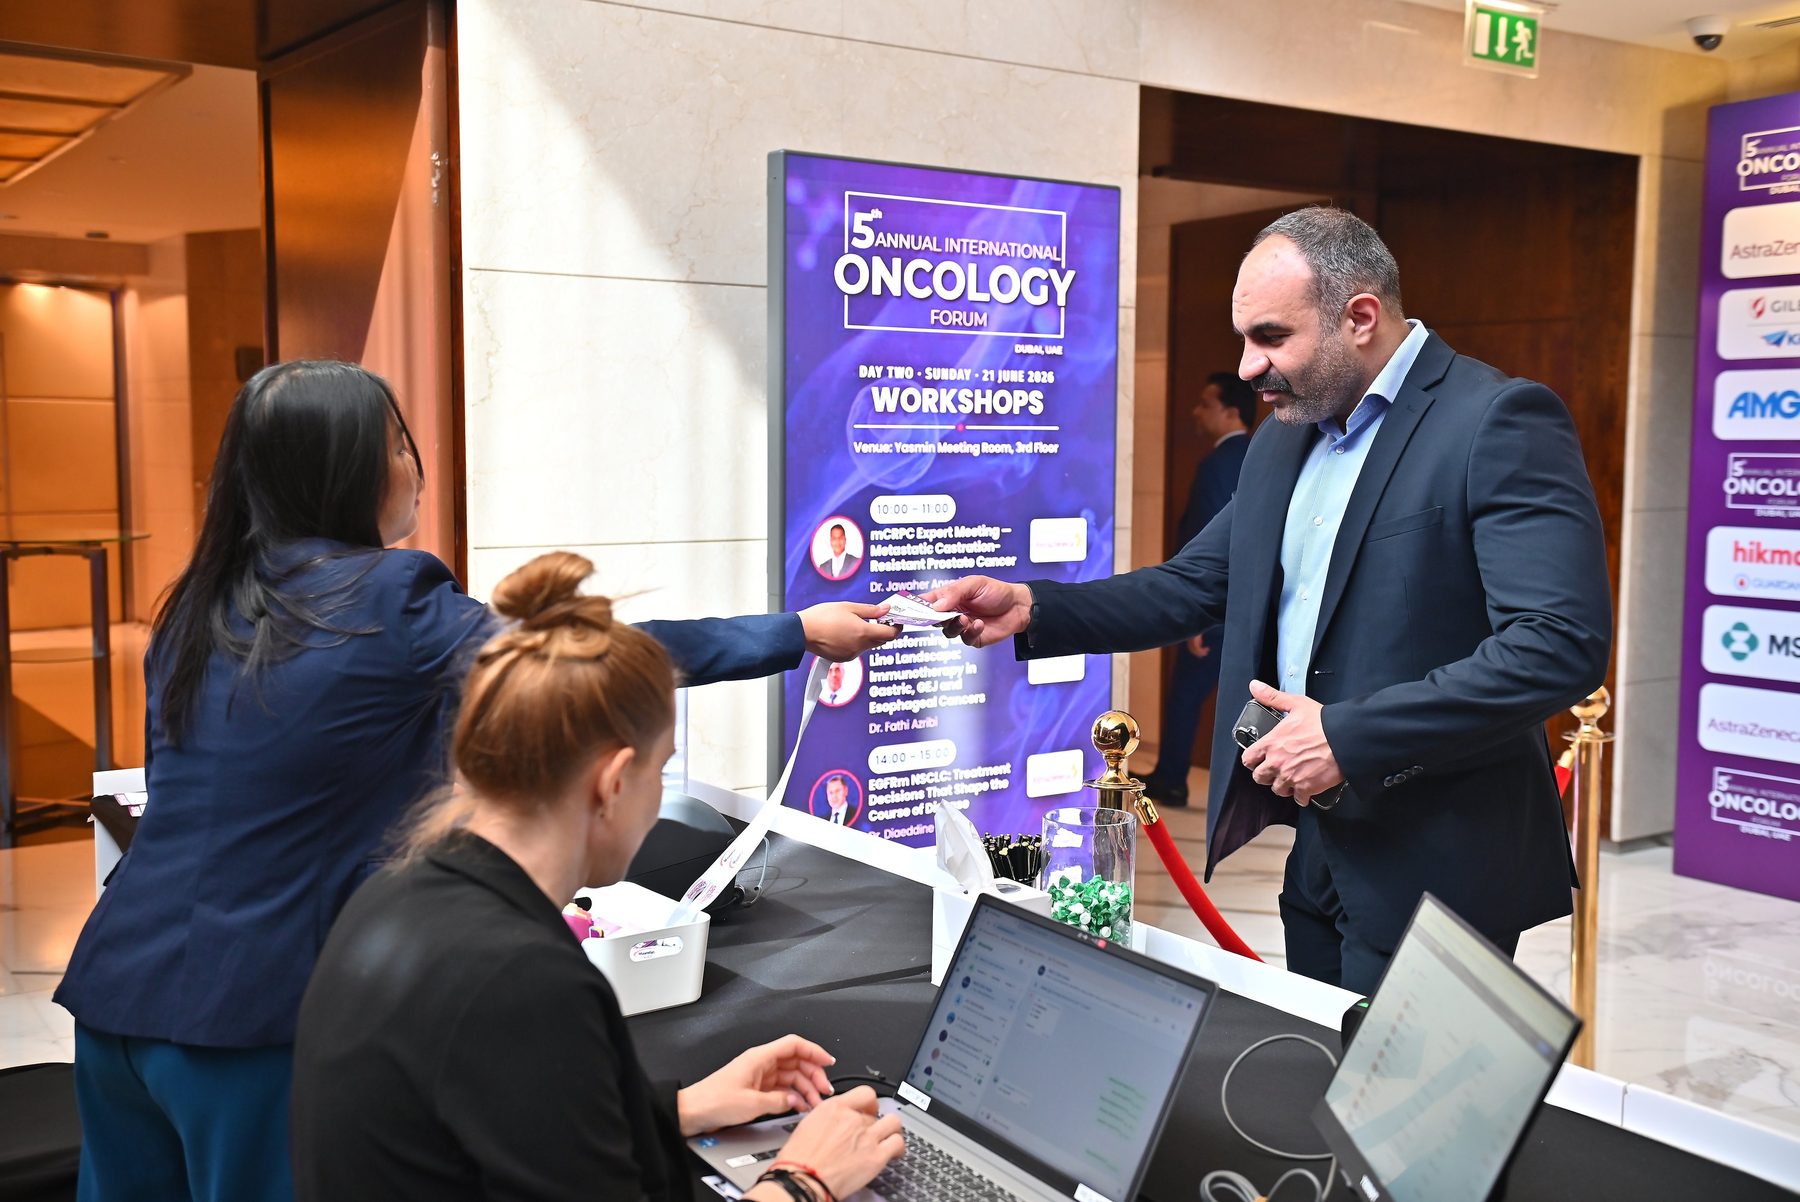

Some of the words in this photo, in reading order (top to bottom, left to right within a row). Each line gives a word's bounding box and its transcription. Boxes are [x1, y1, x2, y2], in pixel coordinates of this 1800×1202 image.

[851, 208, 883, 249] 5th
[875, 232, 942, 252] ANNUAL
[945, 237, 1062, 261] INTERNATIONAL
[834, 253, 1076, 307] ONCOLOGY
[930, 309, 988, 327] FORUM
[1014, 344, 1044, 356] DUBAI,
[1045, 345, 1063, 355] UAE
[859, 365, 883, 378] DAY
[886, 366, 914, 379] TWO
[925, 367, 971, 380] SUNDAY
[982, 369, 995, 381] 21
[997, 370, 1025, 383] JUNE
[1027, 370, 1055, 383] 2026
[871, 386, 1044, 415] WORKSHOPS
[853, 441, 893, 454] Venue:
[894, 441, 936, 454] Yasmin
[937, 441, 980, 456] Meeting
[981, 442, 1014, 455] Room,
[1015, 441, 1033, 453] 3rd
[1034, 441, 1060, 454] Floor
[877, 503, 908, 515] 10:00
[922, 503, 949, 514] 11:00
[870, 527, 916, 541] mCRPC
[916, 525, 954, 542] Expert
[954, 524, 1000, 540] Meeting
[870, 541, 934, 557] Metastatic
[935, 540, 1001, 554] Castration-
[870, 558, 926, 572] Resistant
[926, 556, 975, 570] Prostate
[976, 555, 1017, 568] Cancer
[870, 581, 884, 593] Dr.
[886, 579, 930, 592] Jawaher
[869, 653, 894, 667] Line
[869, 664, 964, 682] Immunotherapy
[965, 661, 977, 675] in
[869, 682, 916, 697] Gastric,
[916, 680, 938, 693] GEJ
[939, 678, 963, 691] and
[869, 696, 938, 715] Esophageal
[938, 693, 986, 707] Cancers
[869, 723, 883, 734] Dr.
[885, 719, 910, 732] Fathi
[875, 752, 906, 765] 14:00
[868, 776, 910, 791] EGFRm
[911, 770, 952, 786] NSCLC:
[952, 762, 1011, 780] Treatment
[868, 789, 925, 806] Decisions
[926, 783, 953, 798] That
[953, 781, 989, 796] Shape
[990, 778, 1009, 790] the
[868, 807, 911, 822] Course
[912, 802, 925, 816] of
[1708, 790, 1800, 821] ONCOLO
[883, 823, 935, 840] Diaeddine
